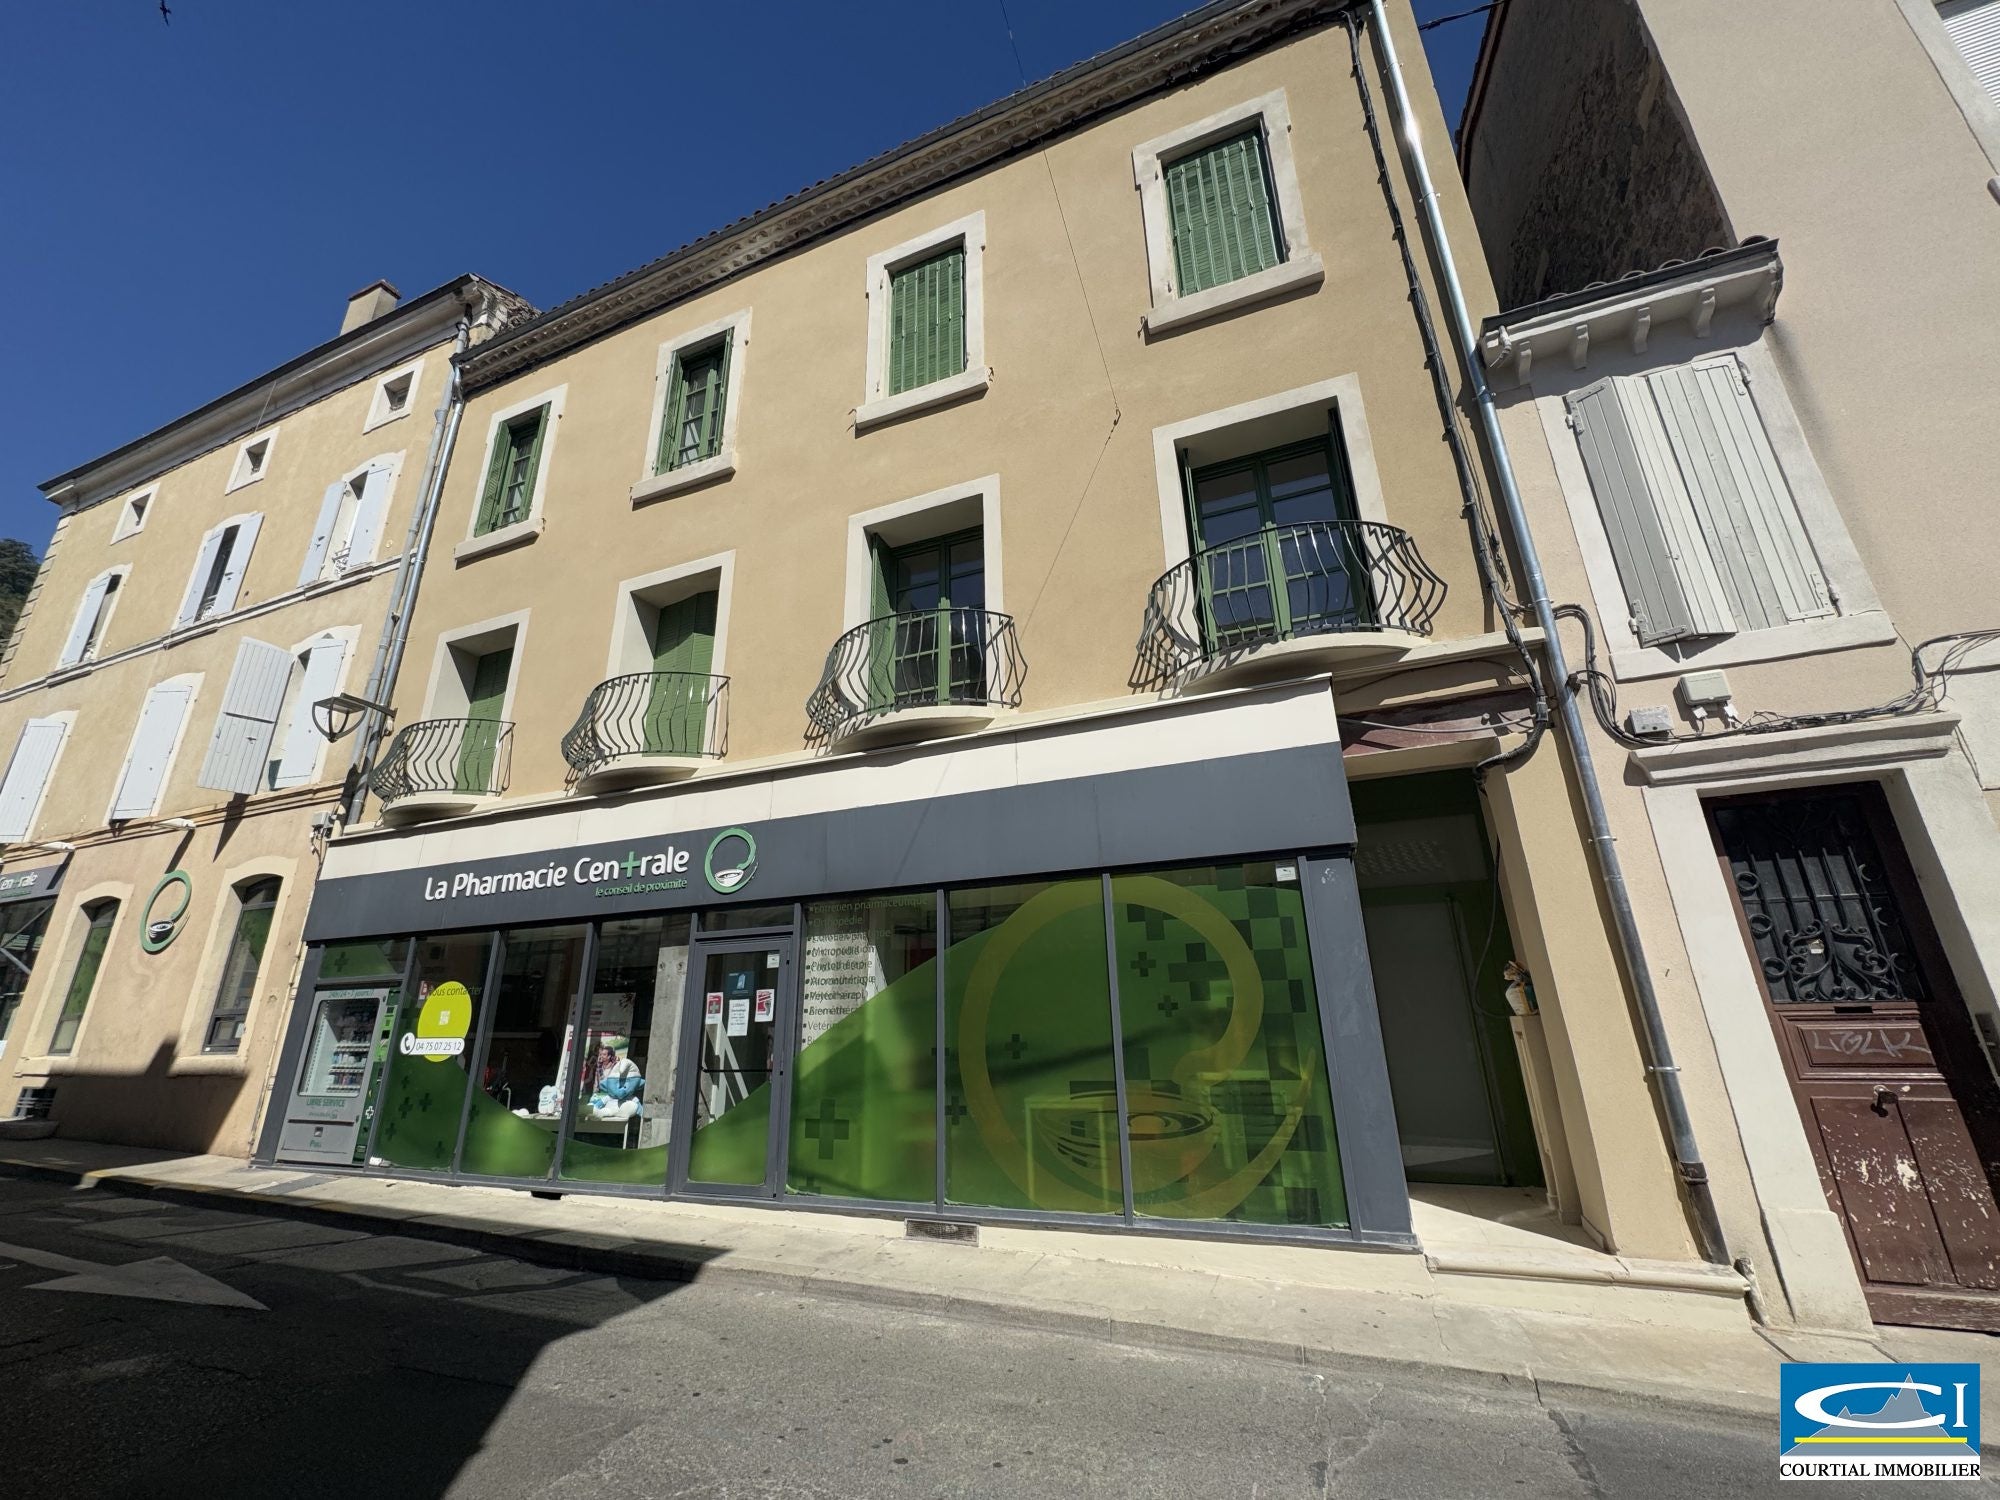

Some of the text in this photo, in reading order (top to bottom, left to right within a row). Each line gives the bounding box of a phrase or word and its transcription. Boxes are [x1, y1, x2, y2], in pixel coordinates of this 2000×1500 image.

[424, 877, 448, 901] La
[452, 861, 568, 898] Pharmacie
[605, 883, 633, 896] conseil
[634, 882, 645, 894] de
[415, 1041, 462, 1051] 04 75 07 25 12
